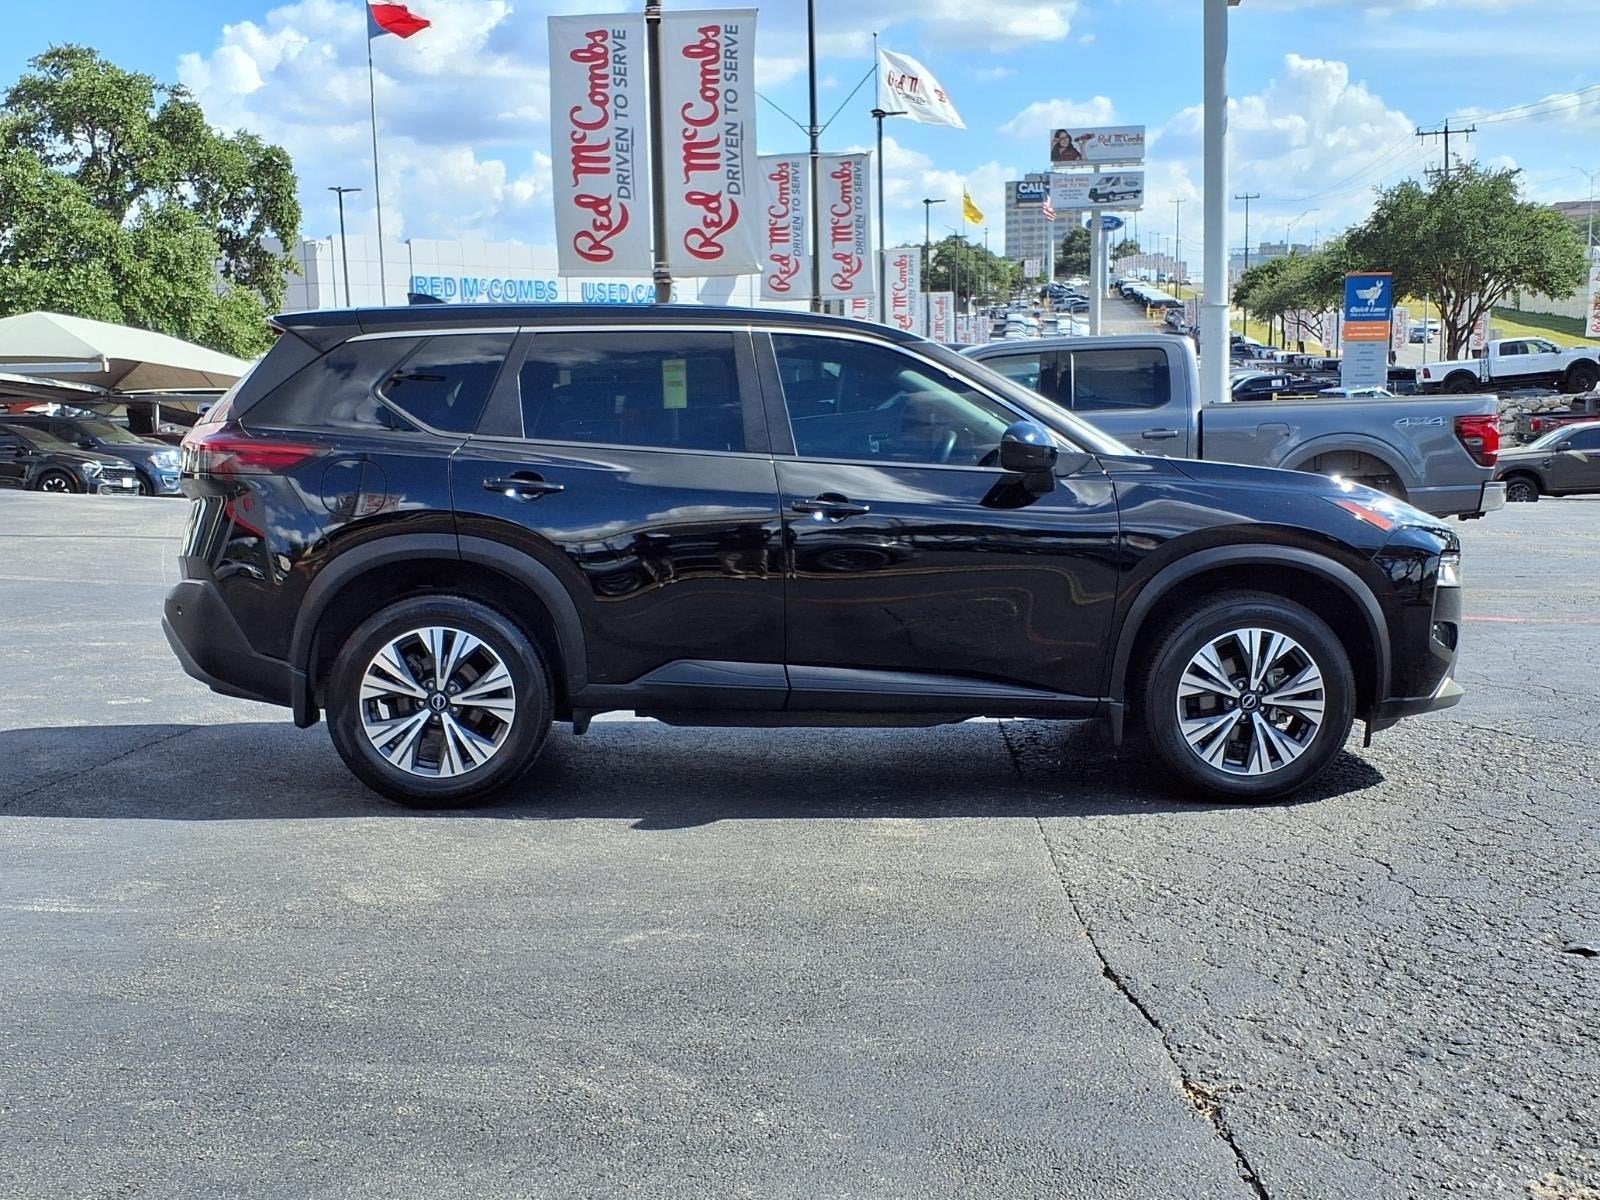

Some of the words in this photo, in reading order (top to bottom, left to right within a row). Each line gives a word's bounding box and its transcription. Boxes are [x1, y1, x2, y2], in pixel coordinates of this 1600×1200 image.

[612, 29, 628, 88] SERVE
[724, 24, 739, 82] SERVE
[569, 29, 612, 187] McCombs
[613, 94, 629, 121] TO
[681, 25, 721, 185] McCombs
[724, 88, 739, 115] TO
[614, 127, 632, 200] DRIVEN
[725, 122, 742, 196] DRIVEN
[791, 161, 800, 195] SERVE
[854, 160, 863, 194] SERVE
[684, 190, 739, 260] Red
[768, 162, 790, 250] McCombs
[791, 197, 801, 214] TO
[830, 160, 853, 249] McCombs
[854, 196, 864, 213] TO
[573, 193, 629, 263] Red
[793, 216, 803, 257] DRIVEN
[855, 216, 864, 255] DRIVEN
[413, 275, 457, 299] RED
[582, 282, 629, 303] USED
[633, 284, 678, 303] CAS
[768, 253, 800, 292] Red
[831, 252, 863, 291] Red
